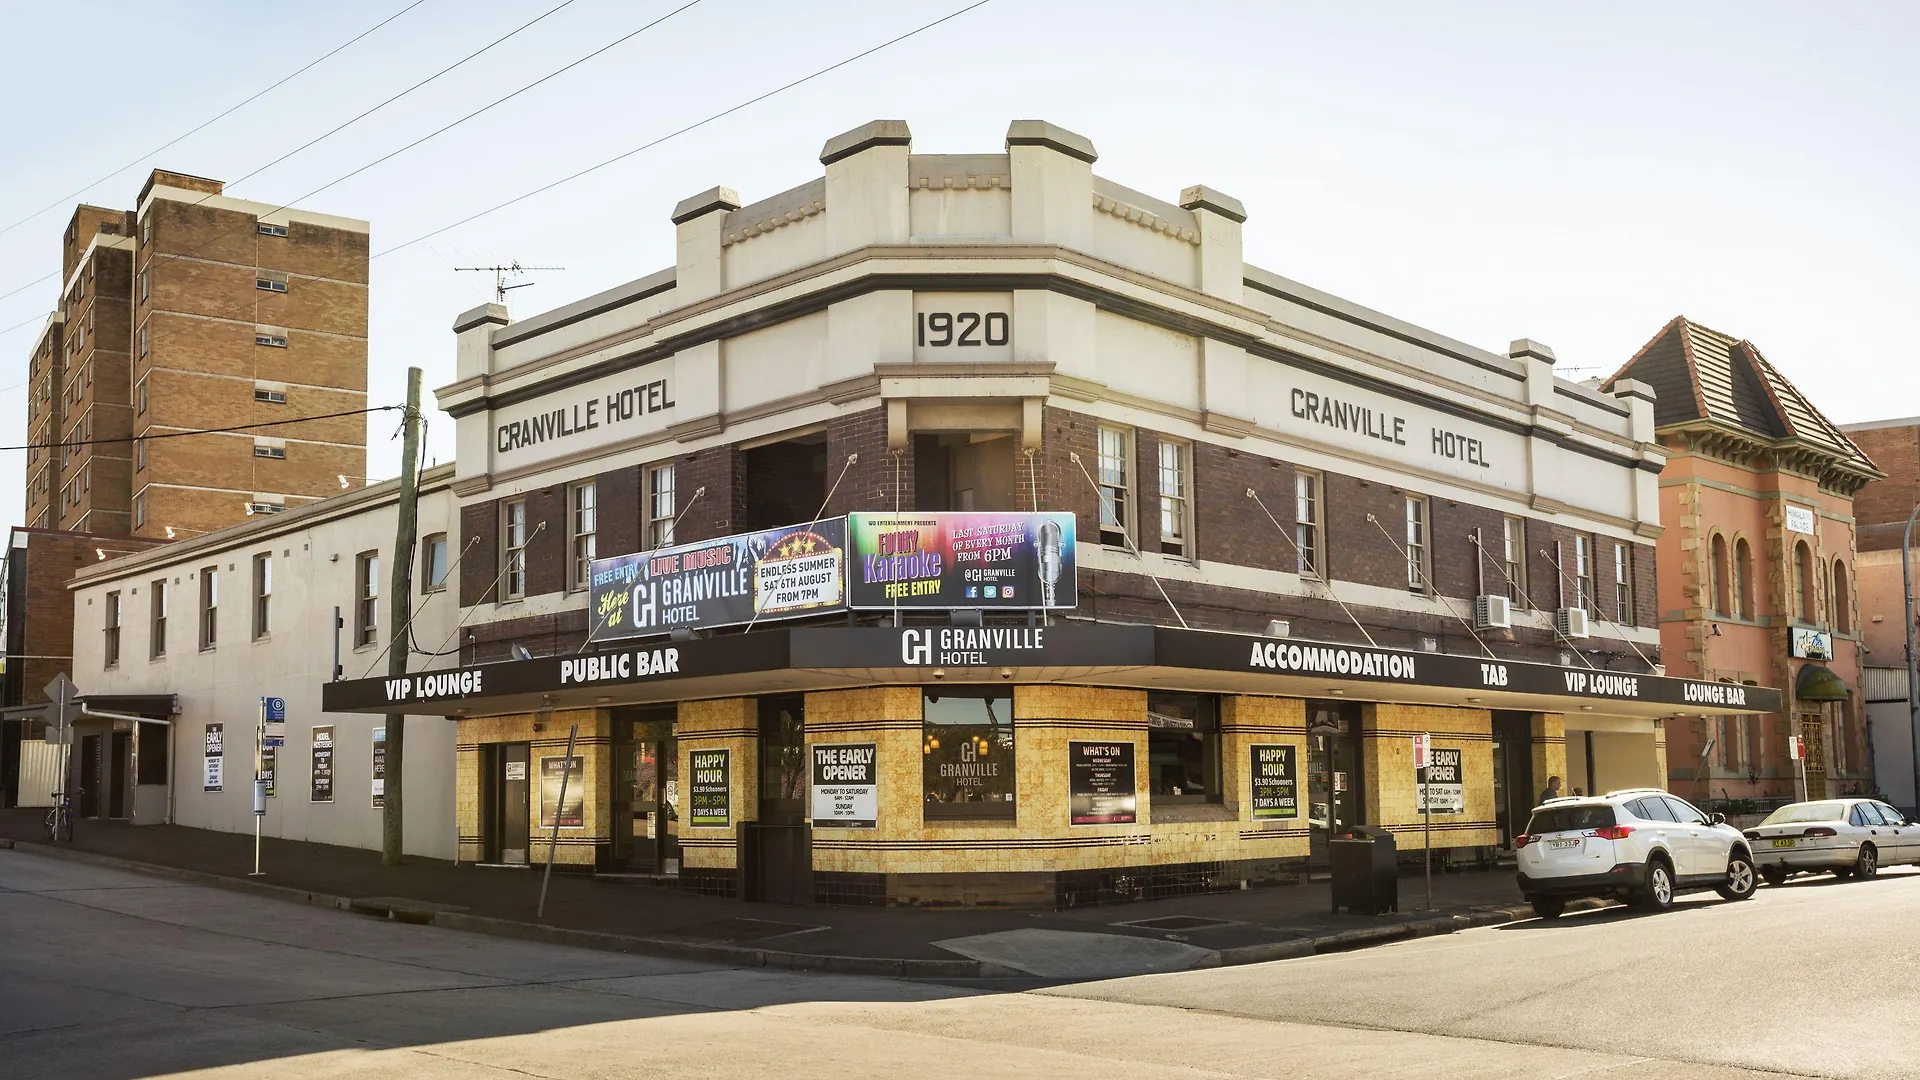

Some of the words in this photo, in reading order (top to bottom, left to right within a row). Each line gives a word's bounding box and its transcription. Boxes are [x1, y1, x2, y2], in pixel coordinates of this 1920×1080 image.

[918, 312, 1009, 347] 1920
[498, 398, 599, 453] GRANVILLE
[606, 379, 676, 425] HOTEL
[1291, 387, 1406, 446] GRANVILLE
[1432, 427, 1490, 468] HOTEL
[952, 528, 974, 539] LAST
[977, 521, 1024, 536] SATURDAY
[878, 529, 919, 556] FUNKY
[952, 540, 964, 551] OF
[964, 537, 994, 550] EVERY
[995, 533, 1025, 546] MONTH
[650, 554, 680, 577] LIVE
[683, 545, 732, 572] MUSIC
[957, 550, 980, 562] FROM
[984, 546, 1012, 562] 6PM
[594, 569, 613, 587] FREE
[614, 561, 639, 580] ENTRY
[760, 563, 797, 578] ENDLESS
[798, 557, 836, 573] SUMMER
[863, 547, 941, 584] Karaoke
[983, 568, 1015, 577] GRANVILLE
[662, 567, 748, 606] GRANVILLE
[764, 579, 779, 591] SAT
[780, 577, 797, 589] 6TH
[798, 572, 832, 586] AUGUST
[885, 582, 909, 599] FREE
[911, 579, 941, 597] ENTRY
[597, 589, 630, 615] Here
[776, 590, 799, 603] FROM
[801, 588, 819, 600] 7PM
[608, 607, 623, 628] at
[662, 605, 700, 625] HOTEL
[940, 628, 1044, 650] GRANVILLE
[560, 653, 630, 684] PUBLIC
[636, 648, 680, 677] BAR
[940, 651, 988, 665] HOTEL
[1250, 641, 1415, 679] ACCOMMODATION
[1480, 663, 1508, 686] TAB
[385, 676, 411, 701] VIP
[416, 670, 482, 698] LOUNGE
[1564, 671, 1587, 693] VIP
[1590, 674, 1638, 697] LOUNGE
[1683, 683, 1725, 704] LOUNGE
[1727, 687, 1746, 705] BAR
[206, 731, 223, 744] EARLY
[316, 732, 330, 741] MODEL
[206, 743, 223, 753] OPENER
[815, 749, 838, 765] THE
[839, 748, 874, 765] EARLY
[1082, 746, 1110, 756] WHAT'S
[1110, 746, 1121, 756] ON
[1259, 749, 1287, 762] HAPPY
[694, 754, 725, 769] HAPPY
[1435, 751, 1459, 766] EARLY
[697, 769, 723, 784] HOUR
[822, 765, 867, 781] OPENER
[940, 763, 998, 777] GRANVILLE
[1262, 763, 1285, 776] HOUR
[705, 785, 727, 793] Schooners
[956, 777, 984, 786] HOTEL
[1254, 778, 1268, 786] $3.90
[1268, 778, 1293, 786] Schooners
[694, 795, 708, 806] 3PM
[712, 794, 726, 805] 5PM
[1259, 787, 1272, 797] 3PM
[1276, 787, 1289, 796] 5PM
[1254, 798, 1258, 807] 7
[1259, 798, 1274, 807] DAYS
[1274, 798, 1279, 807] A
[1279, 797, 1295, 806] WEEK
[693, 808, 697, 816] 7
[697, 808, 709, 816] DAYS
[709, 808, 713, 816] A
[713, 808, 727, 816] WEEK
